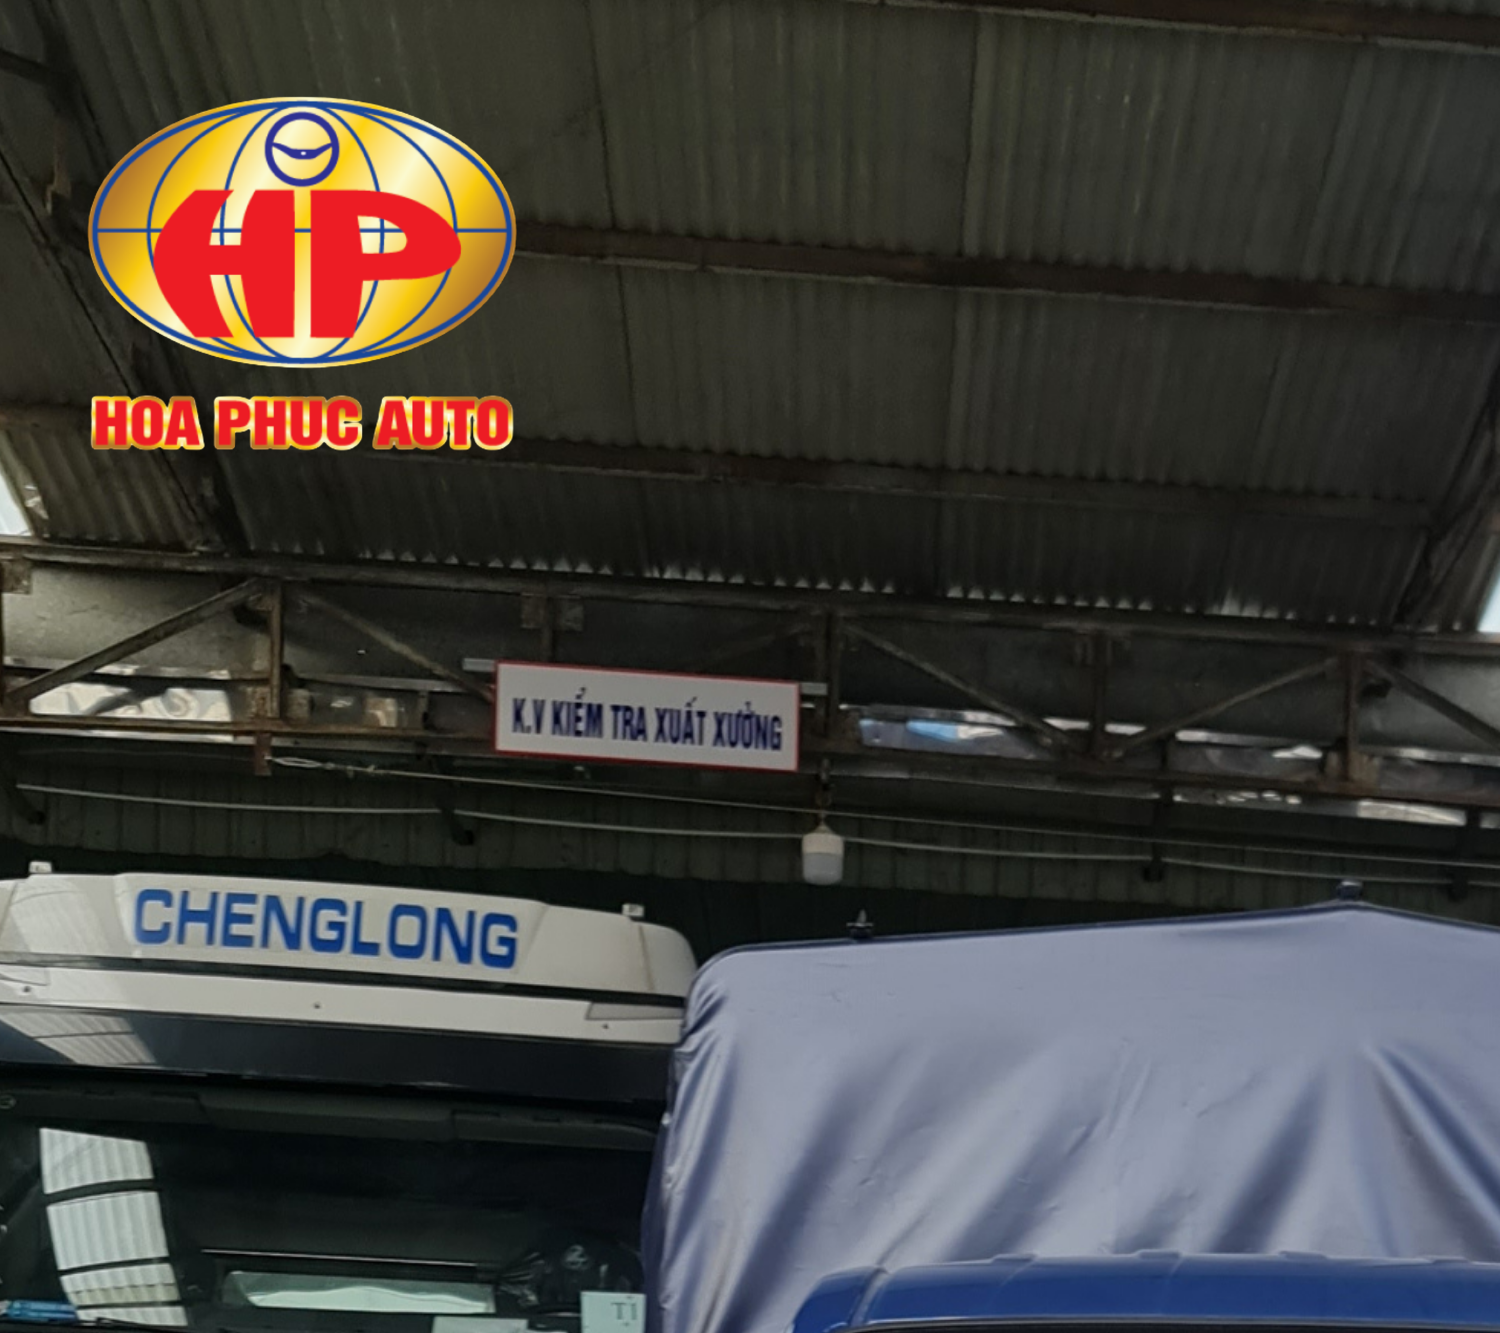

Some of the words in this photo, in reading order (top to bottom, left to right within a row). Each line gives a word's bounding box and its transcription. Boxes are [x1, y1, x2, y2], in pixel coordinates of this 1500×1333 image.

[512, 698, 545, 734] K.V
[551, 687, 604, 739] KIỂM
[609, 704, 648, 742] TRA
[653, 697, 706, 746] XUẤT
[711, 701, 783, 751] XƯỞNG
[134, 887, 518, 969] CHENGLONG
